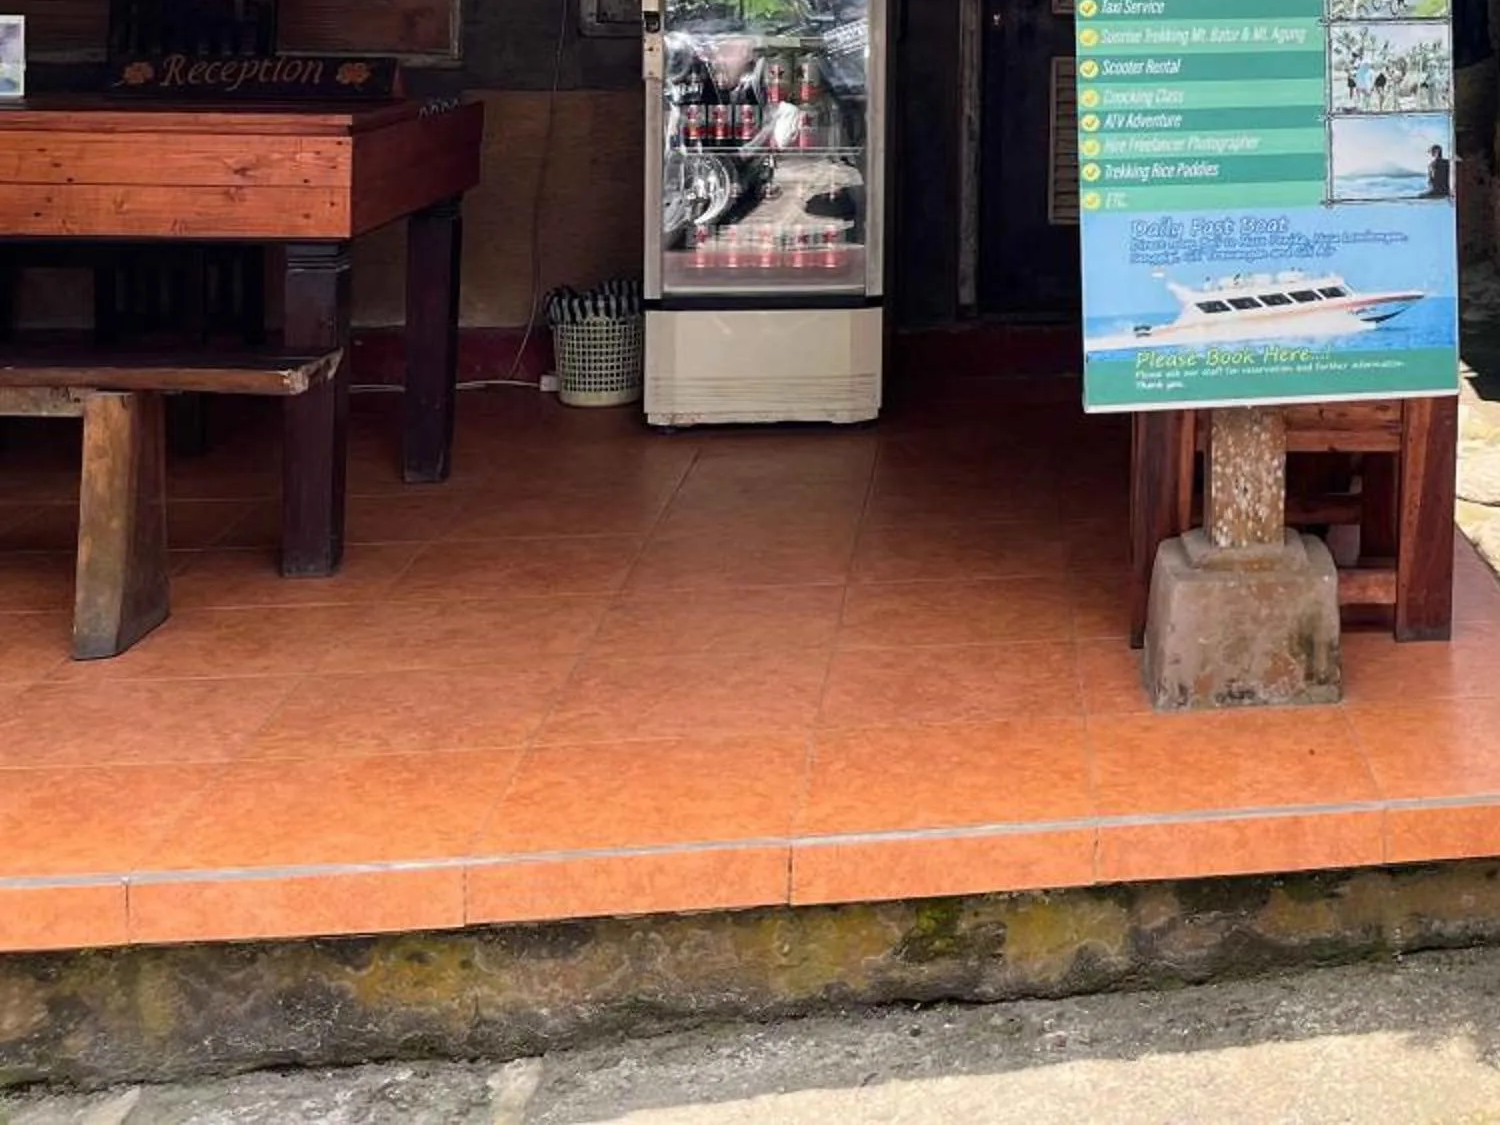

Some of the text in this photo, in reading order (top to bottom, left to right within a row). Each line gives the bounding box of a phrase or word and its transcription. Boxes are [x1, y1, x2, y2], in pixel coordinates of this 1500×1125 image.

[1101, 0, 1124, 15] Taxi
[1271, 25, 1307, 44] Agung
[160, 53, 324, 91] Reception
[1102, 57, 1182, 76] Scooter Rental
[1155, 88, 1184, 104] Class
[1104, 112, 1183, 129] ATV Adventure
[1104, 159, 1219, 182] Trekking Rice Paddies
[1131, 216, 1289, 238] Daily Fast Boat
[1135, 350, 1197, 369] Please
[1204, 346, 1255, 366] Book
